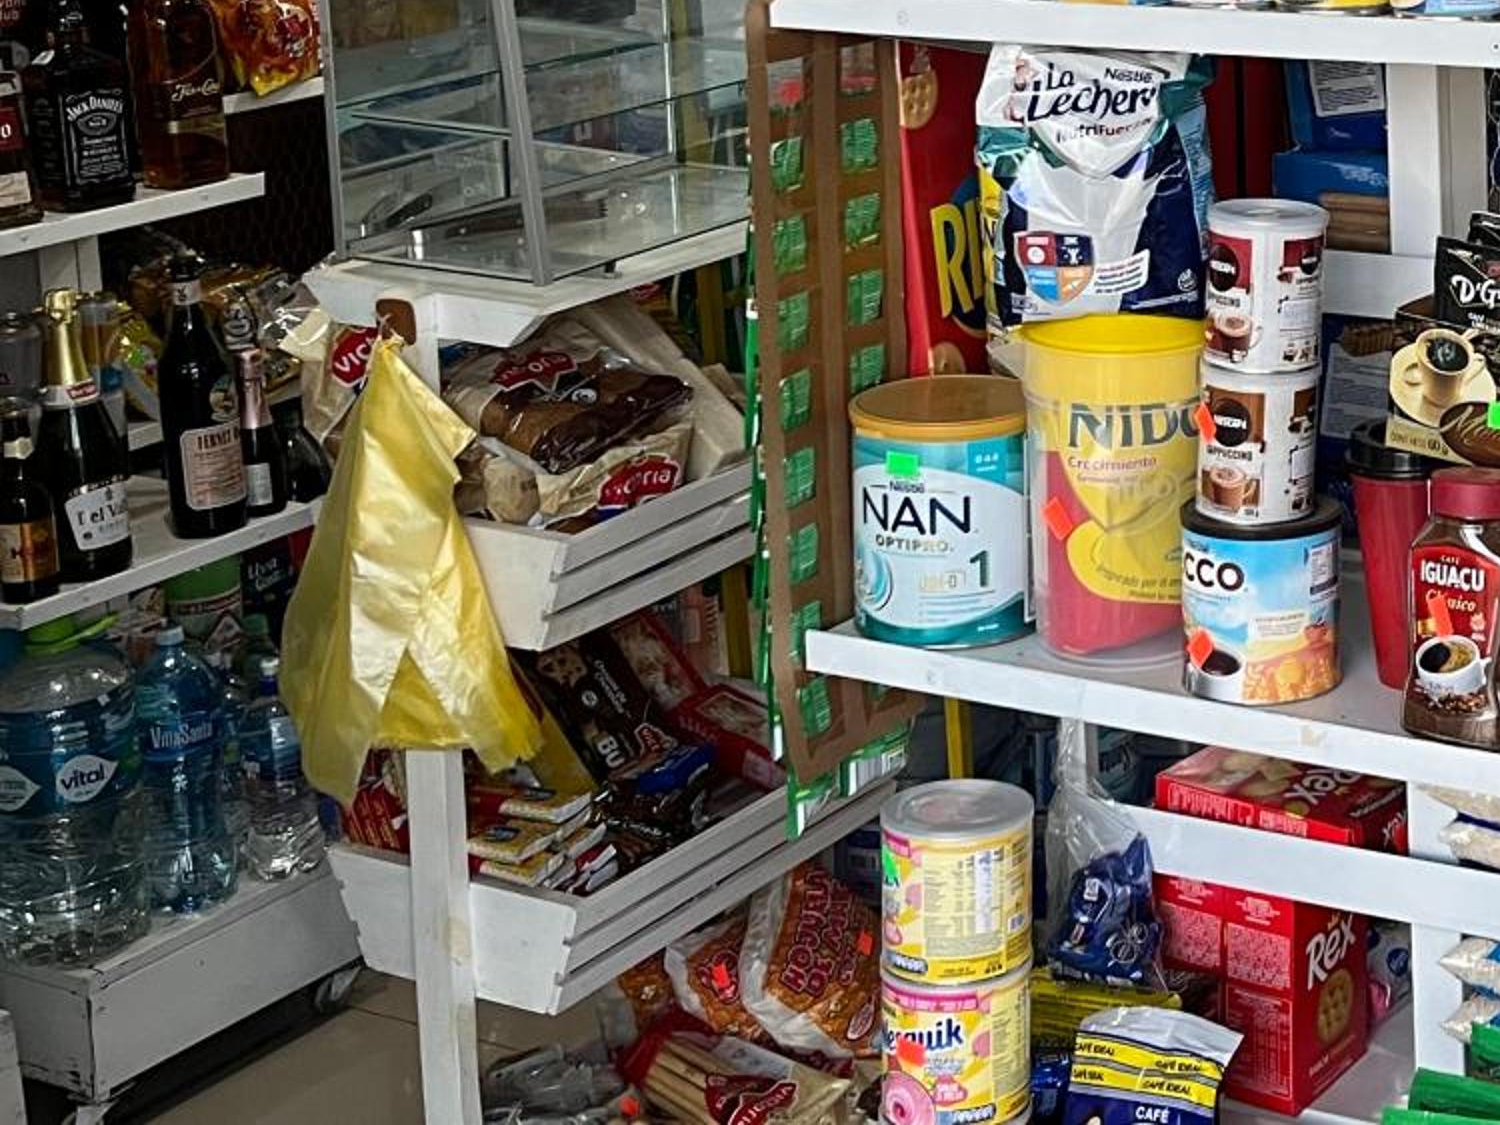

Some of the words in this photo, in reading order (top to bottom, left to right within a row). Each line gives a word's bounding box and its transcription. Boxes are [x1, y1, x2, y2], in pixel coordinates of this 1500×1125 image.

[1046, 62, 1076, 91] La
[862, 486, 972, 536] NAN
[875, 534, 951, 552] OPTIPRO
[969, 550, 990, 589] 1
[61, 763, 105, 791] vital
[1305, 914, 1358, 991] Rex
[1135, 1104, 1170, 1125] CAFÉ
